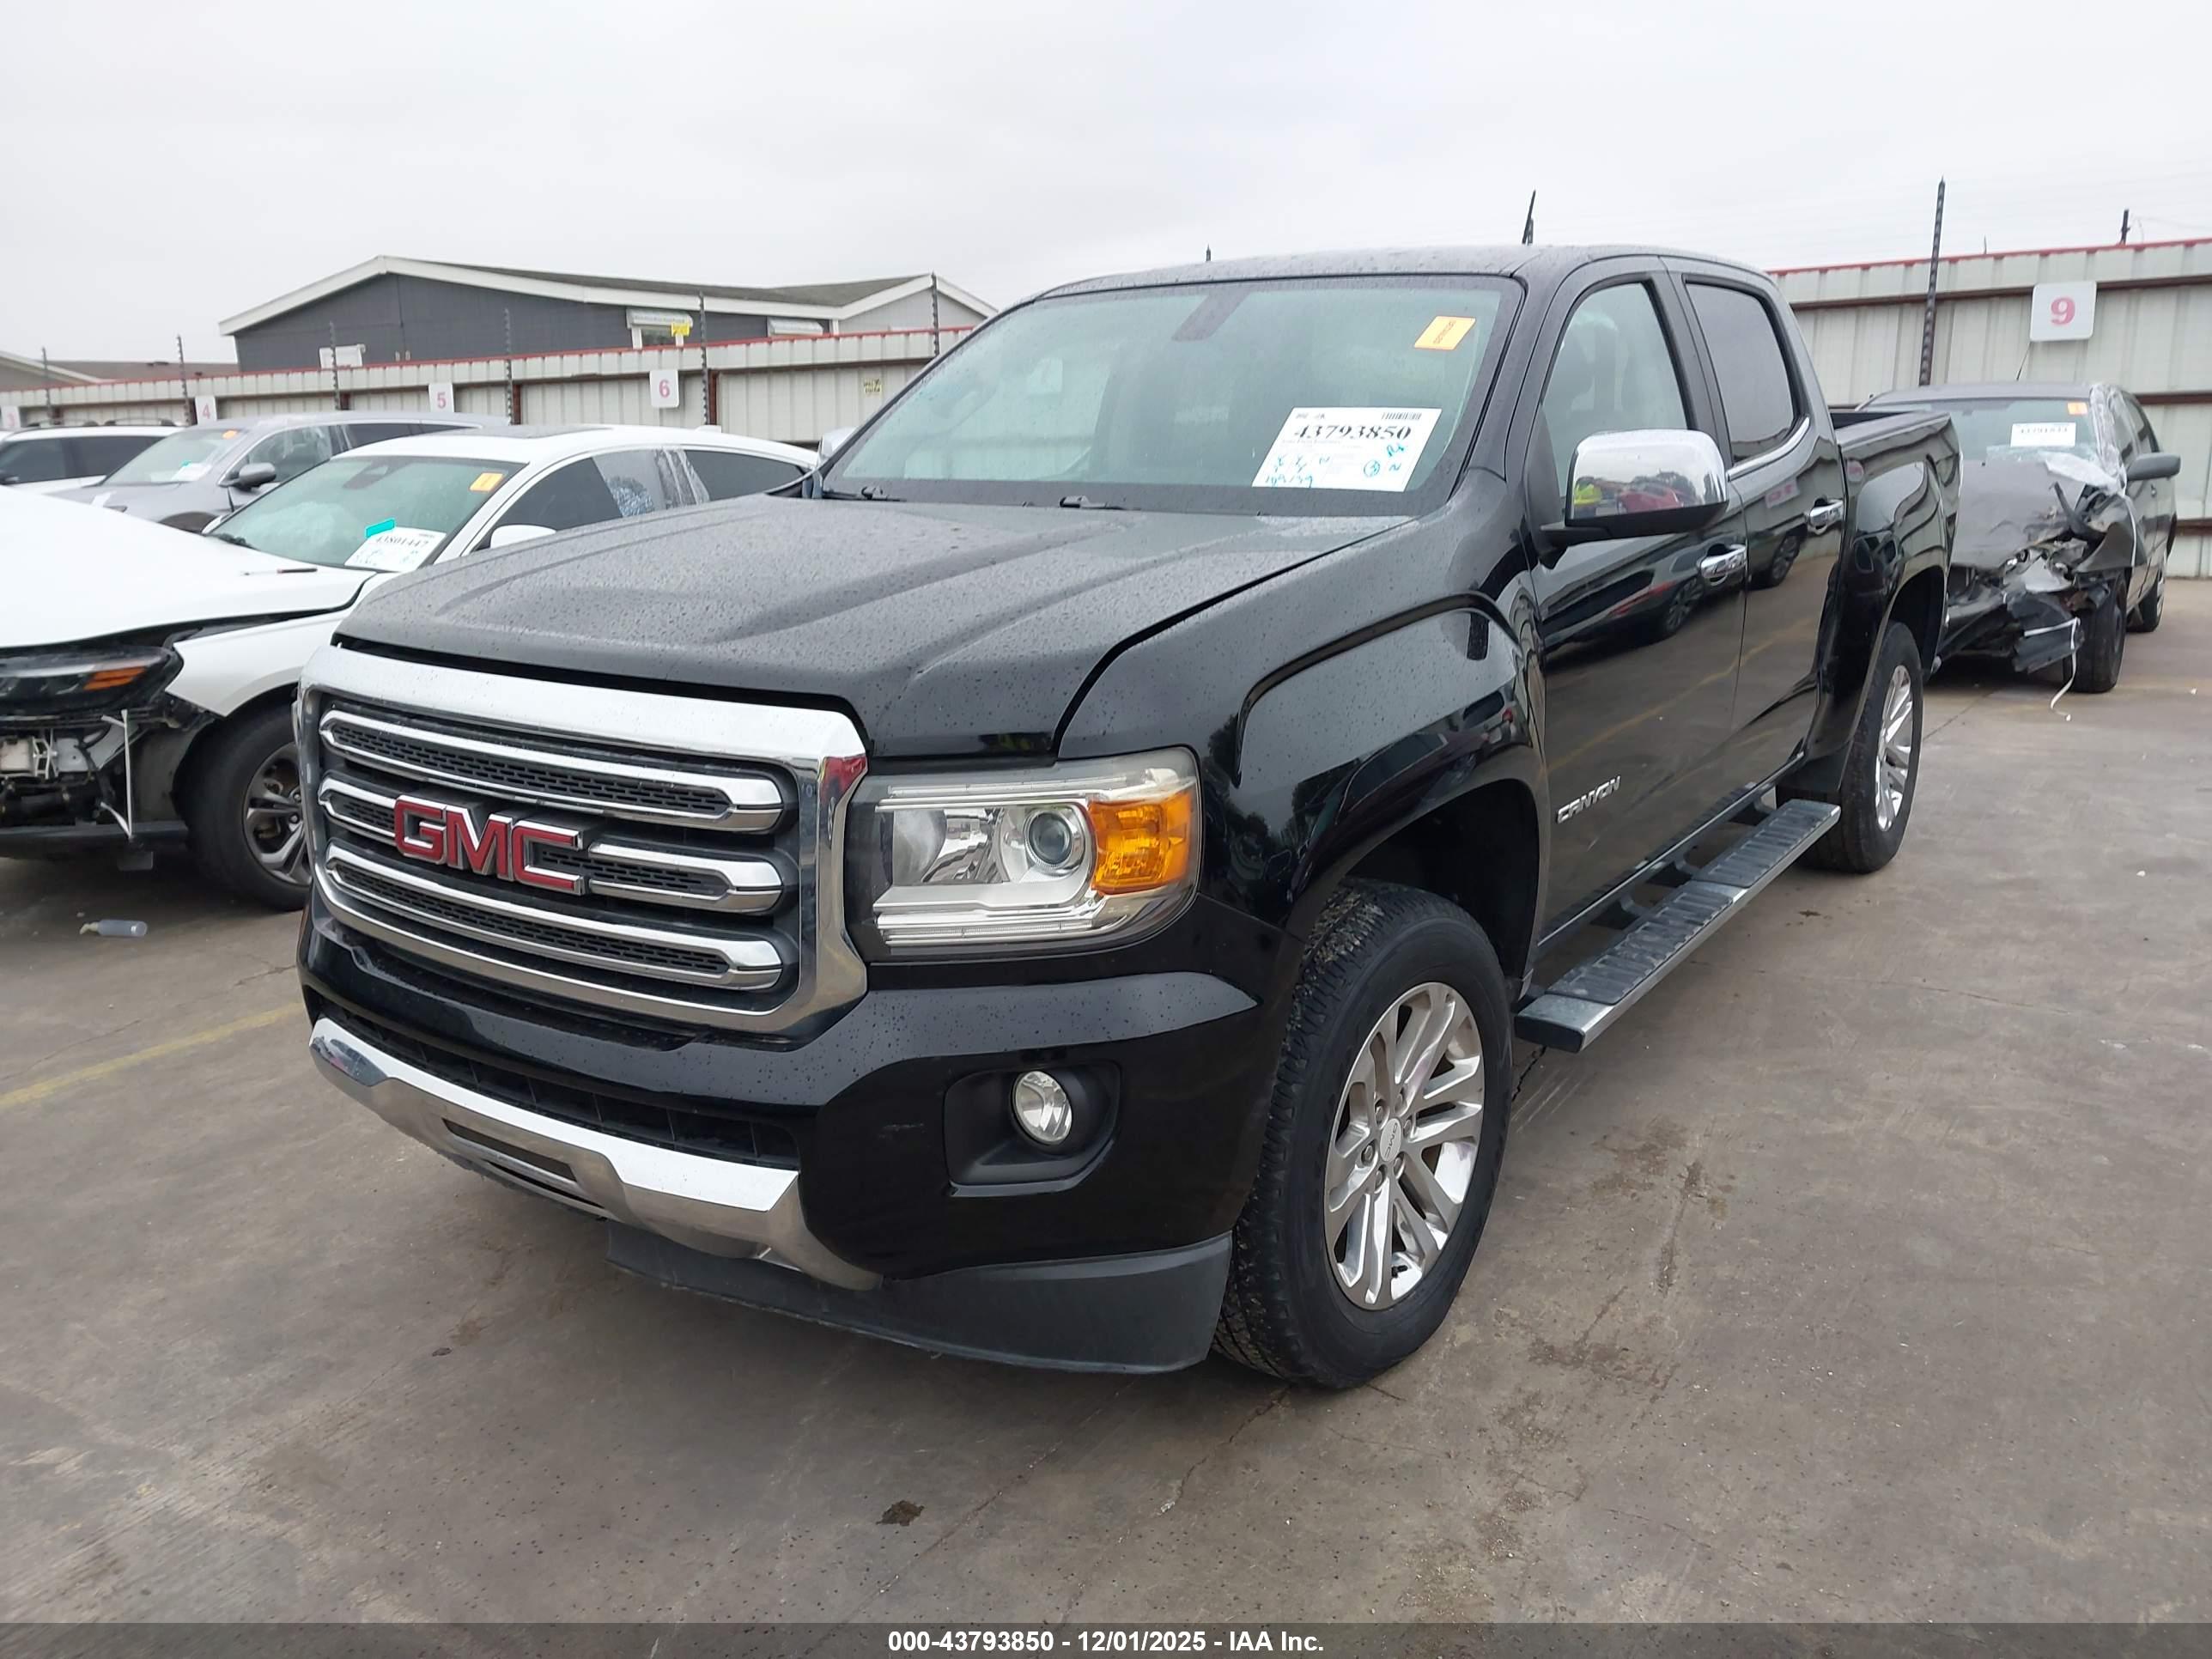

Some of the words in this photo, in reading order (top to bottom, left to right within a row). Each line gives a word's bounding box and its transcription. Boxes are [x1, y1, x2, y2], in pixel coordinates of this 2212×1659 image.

[2051, 296, 2075, 325] 9
[436, 392, 447, 409] 5
[658, 379, 671, 398] 6
[202, 404, 211, 419] 4
[1293, 423, 1413, 441] 43793850
[1557, 775, 1621, 824] CANYON
[393, 793, 586, 896] GMC
[1383, 1121, 1399, 1160] GMC
